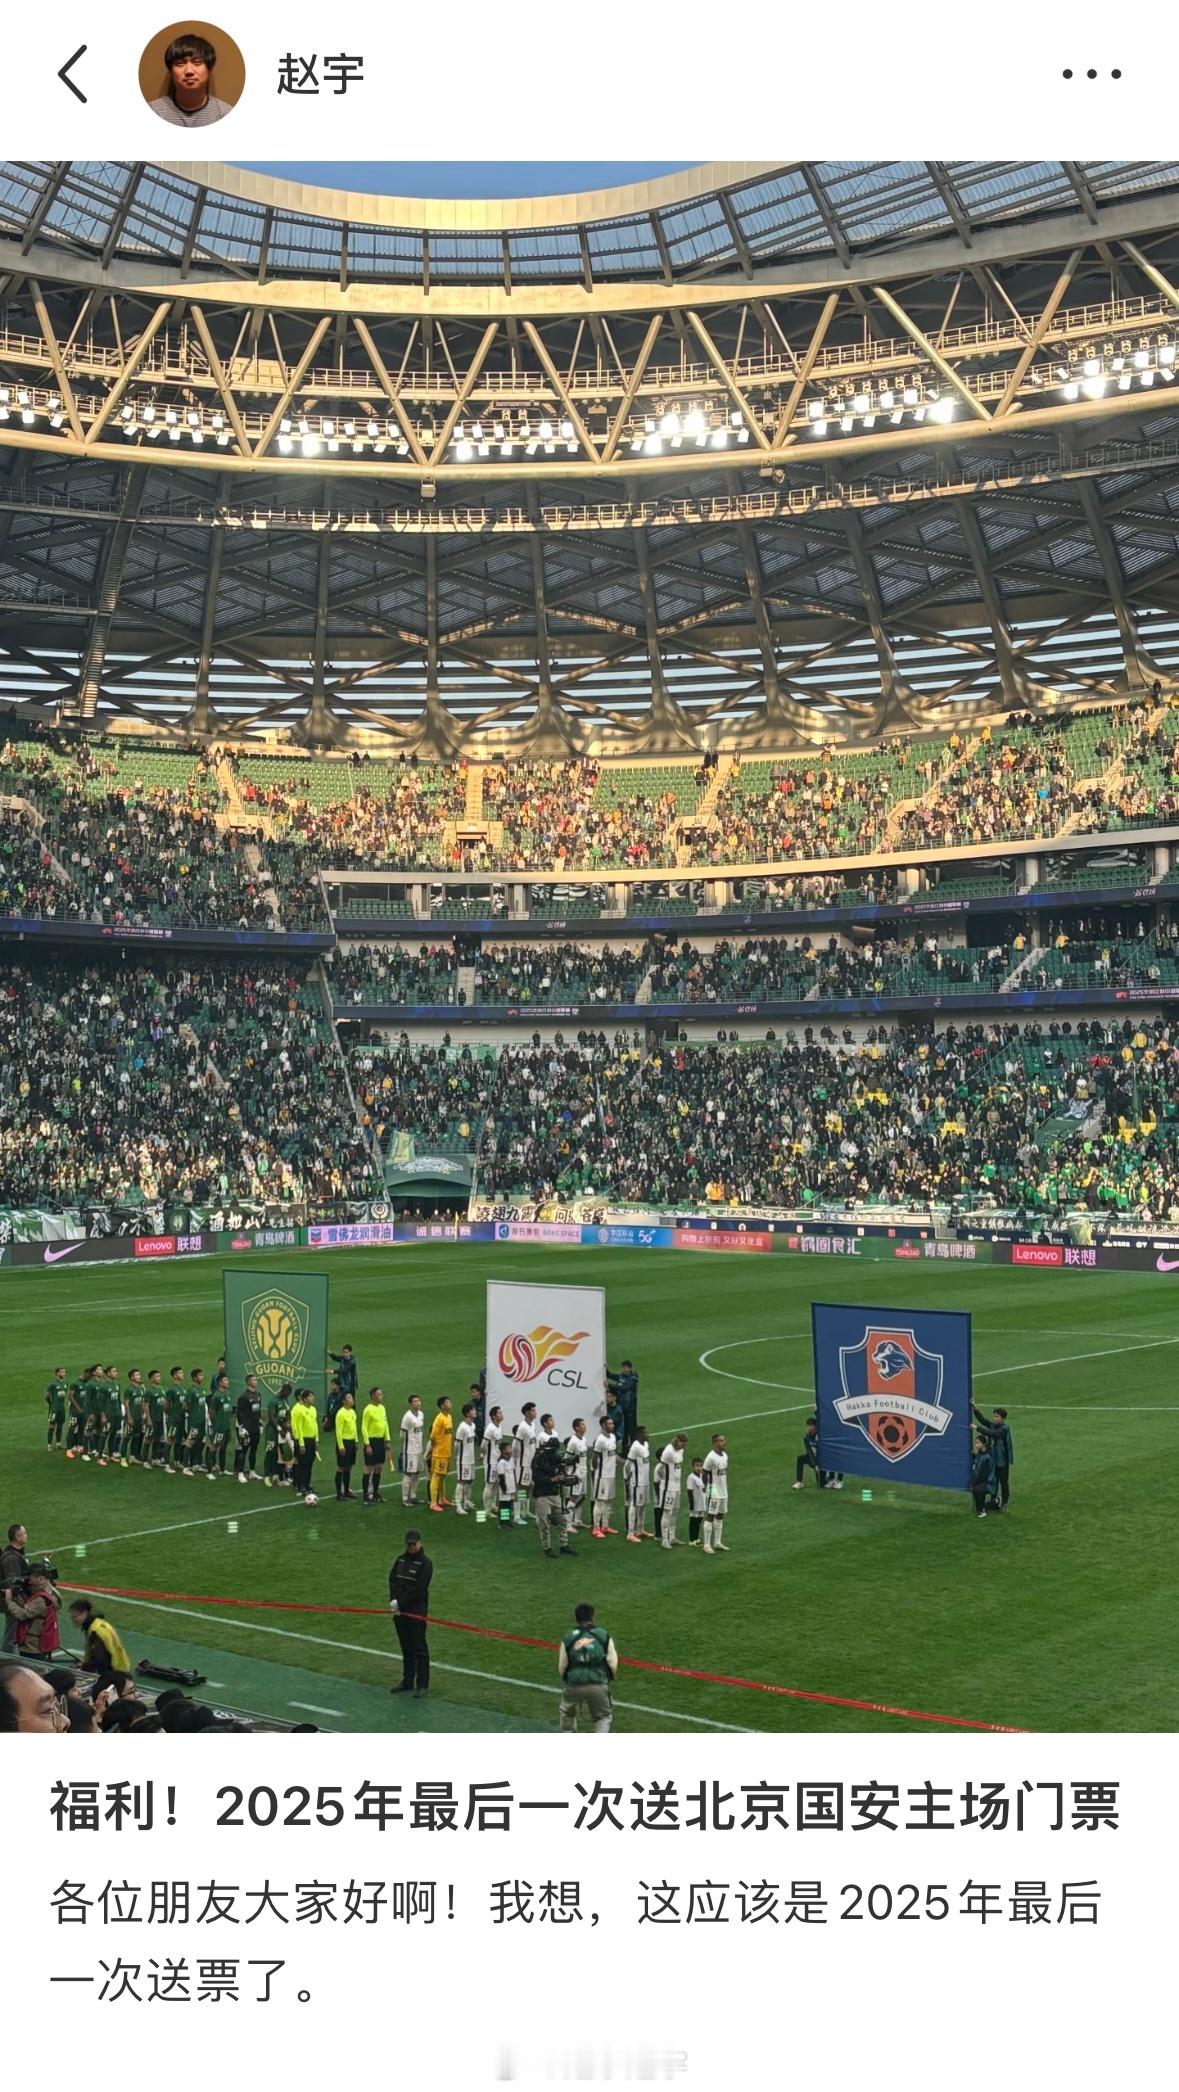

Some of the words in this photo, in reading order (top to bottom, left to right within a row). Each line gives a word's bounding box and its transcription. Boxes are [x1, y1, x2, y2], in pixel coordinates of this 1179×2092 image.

[255, 1231, 295, 1246] 青岛啤酒
[327, 1225, 392, 1242] 雪佛龙润滑油
[138, 1241, 173, 1252] Lenovo
[177, 1235, 202, 1252] 联想
[924, 1242, 976, 1259] 青岛啤酒
[1016, 1249, 1058, 1261] Lenovo
[1064, 1248, 1097, 1265] 联想
[255, 1362, 295, 1378] GUOAN
[547, 1368, 588, 1390] CSL
[846, 1401, 871, 1411] Hakka
[874, 1399, 915, 1412] Football
[918, 1407, 940, 1423] Club
